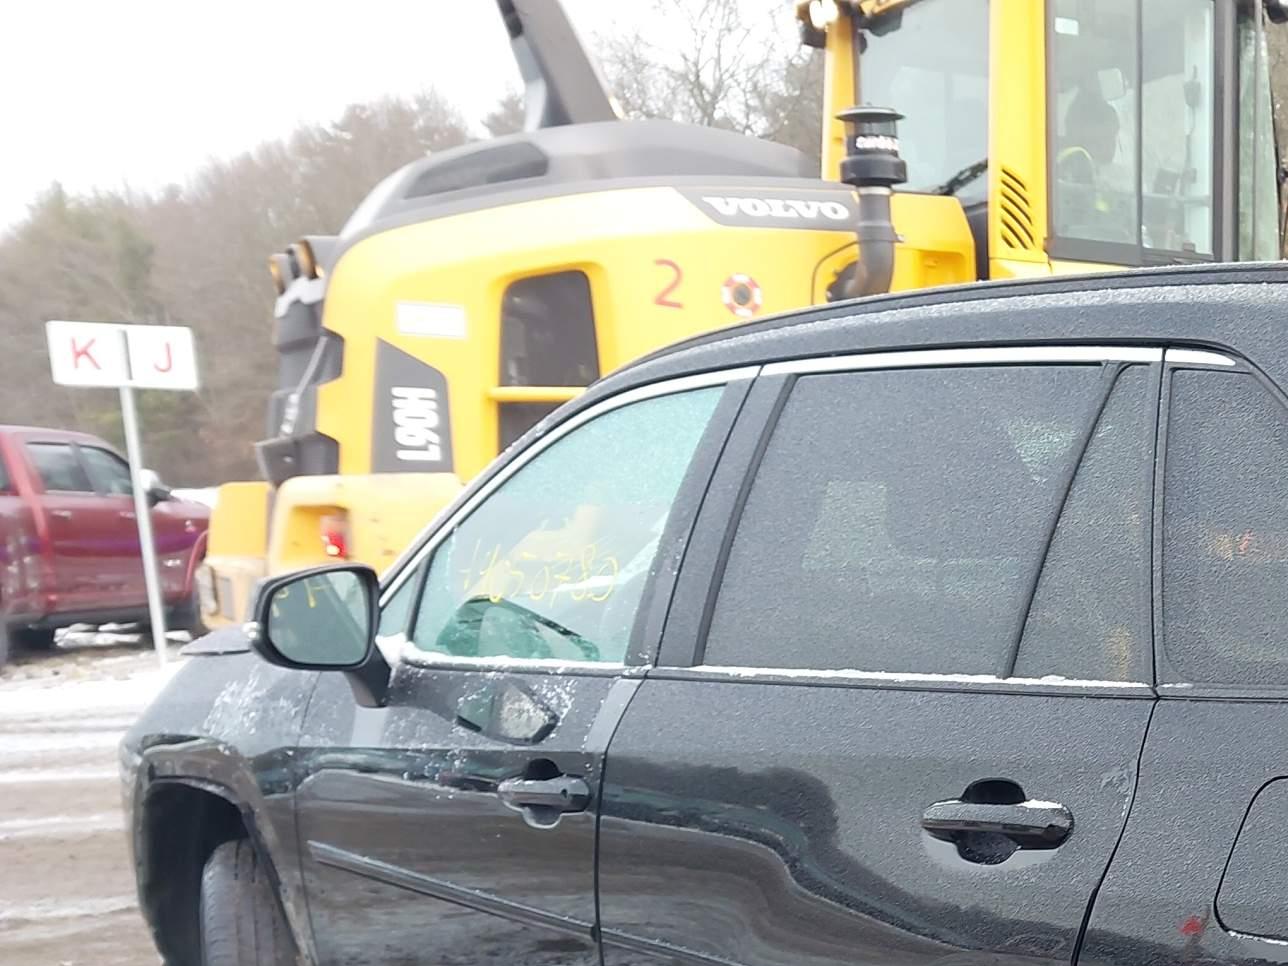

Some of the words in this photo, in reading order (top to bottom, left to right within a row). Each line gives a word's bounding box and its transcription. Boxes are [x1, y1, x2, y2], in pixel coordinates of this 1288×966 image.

[702, 196, 850, 220] VOLVO
[653, 258, 684, 309] 2
[70, 337, 102, 370] K
[154, 341, 173, 373] J
[390, 386, 442, 461] L90H
